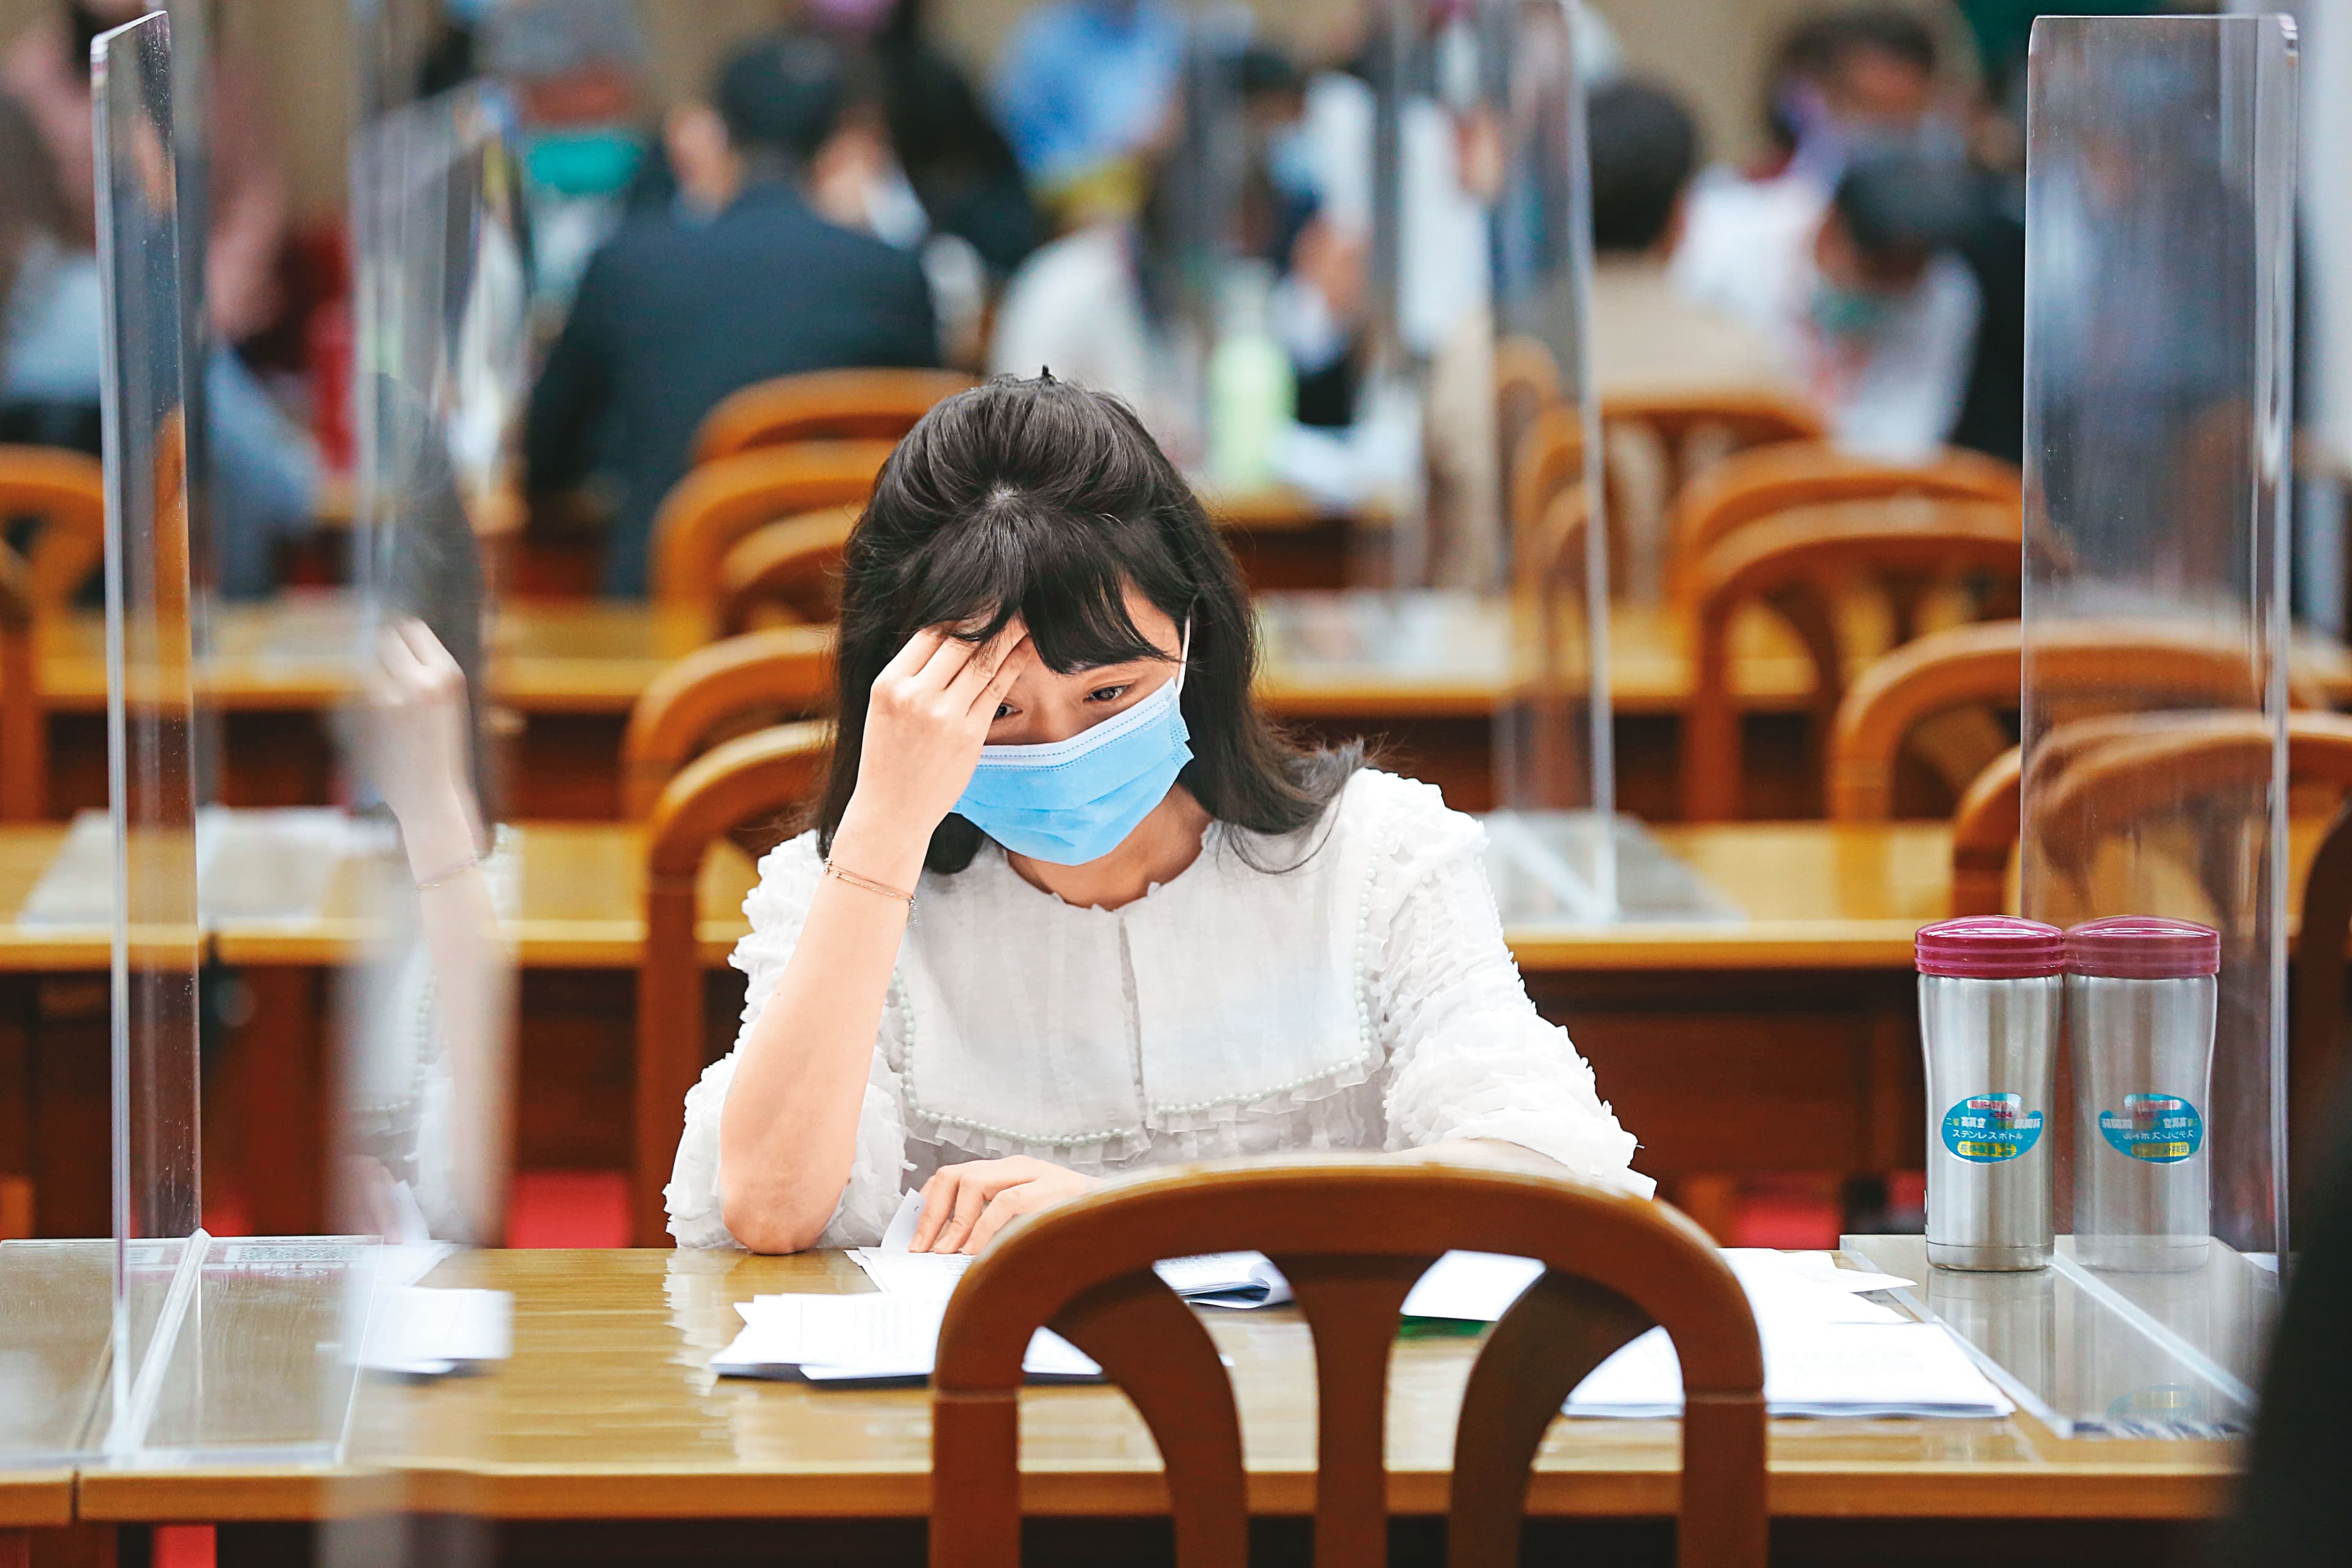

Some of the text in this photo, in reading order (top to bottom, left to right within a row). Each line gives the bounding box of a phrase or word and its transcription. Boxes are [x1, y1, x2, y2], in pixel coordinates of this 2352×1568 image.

[1953, 1129, 2023, 1140] ステンレスボトル
